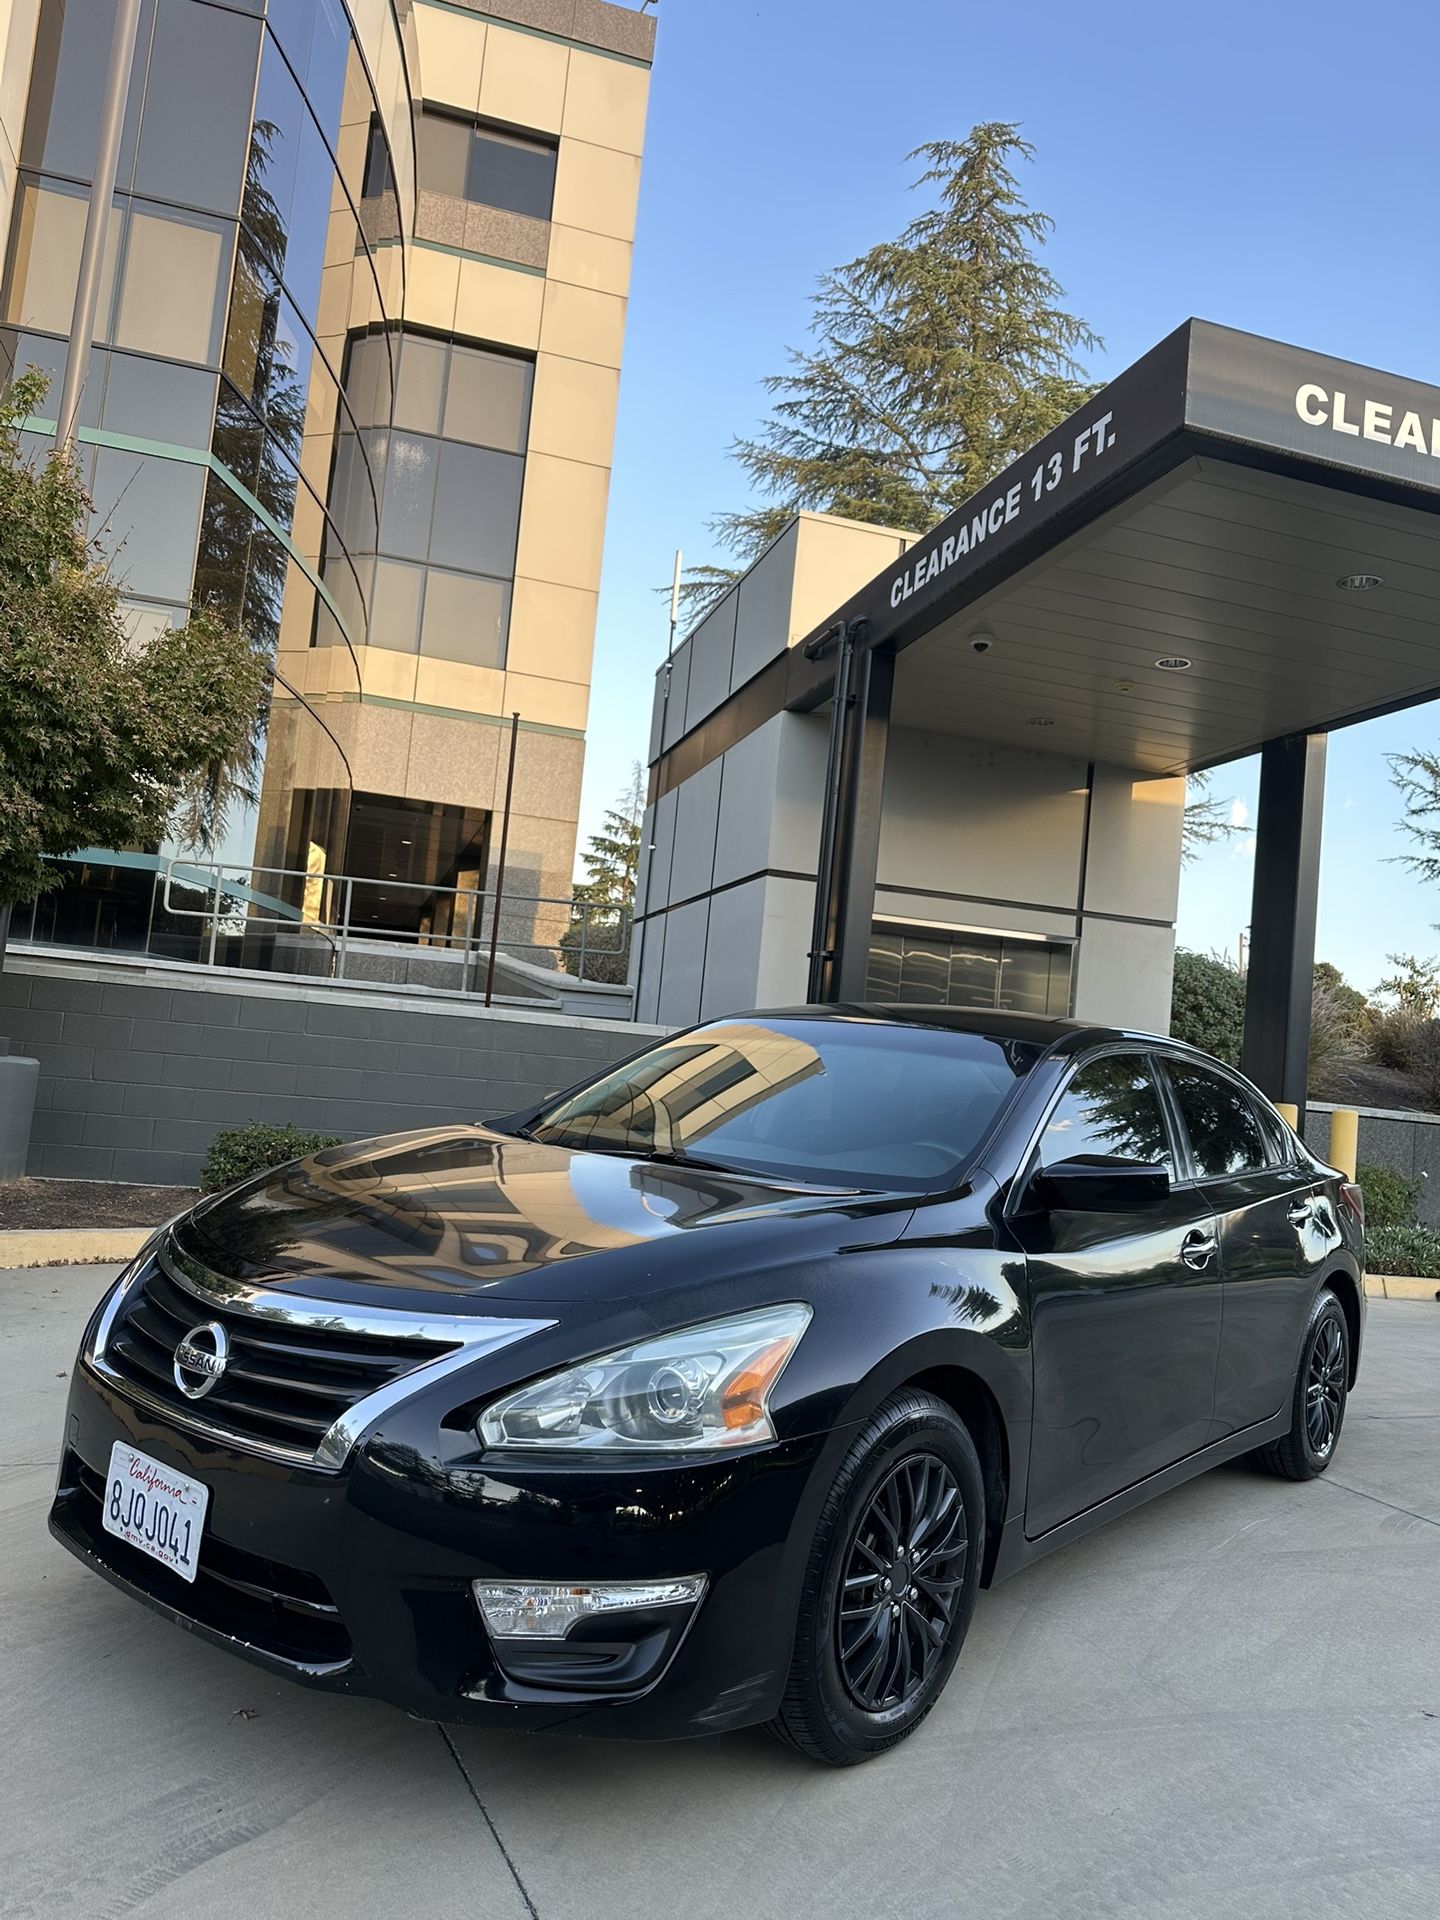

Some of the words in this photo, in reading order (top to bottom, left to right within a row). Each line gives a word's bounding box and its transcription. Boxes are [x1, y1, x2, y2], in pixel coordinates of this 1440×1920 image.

[890, 482, 1022, 608] CLEARANCE
[1031, 452, 1063, 502] 13
[1072, 411, 1116, 473] FT.
[129, 1457, 187, 1505] California
[110, 1479, 191, 1566] 8JQJ041
[124, 1530, 174, 1563] dmv.ca.gov
